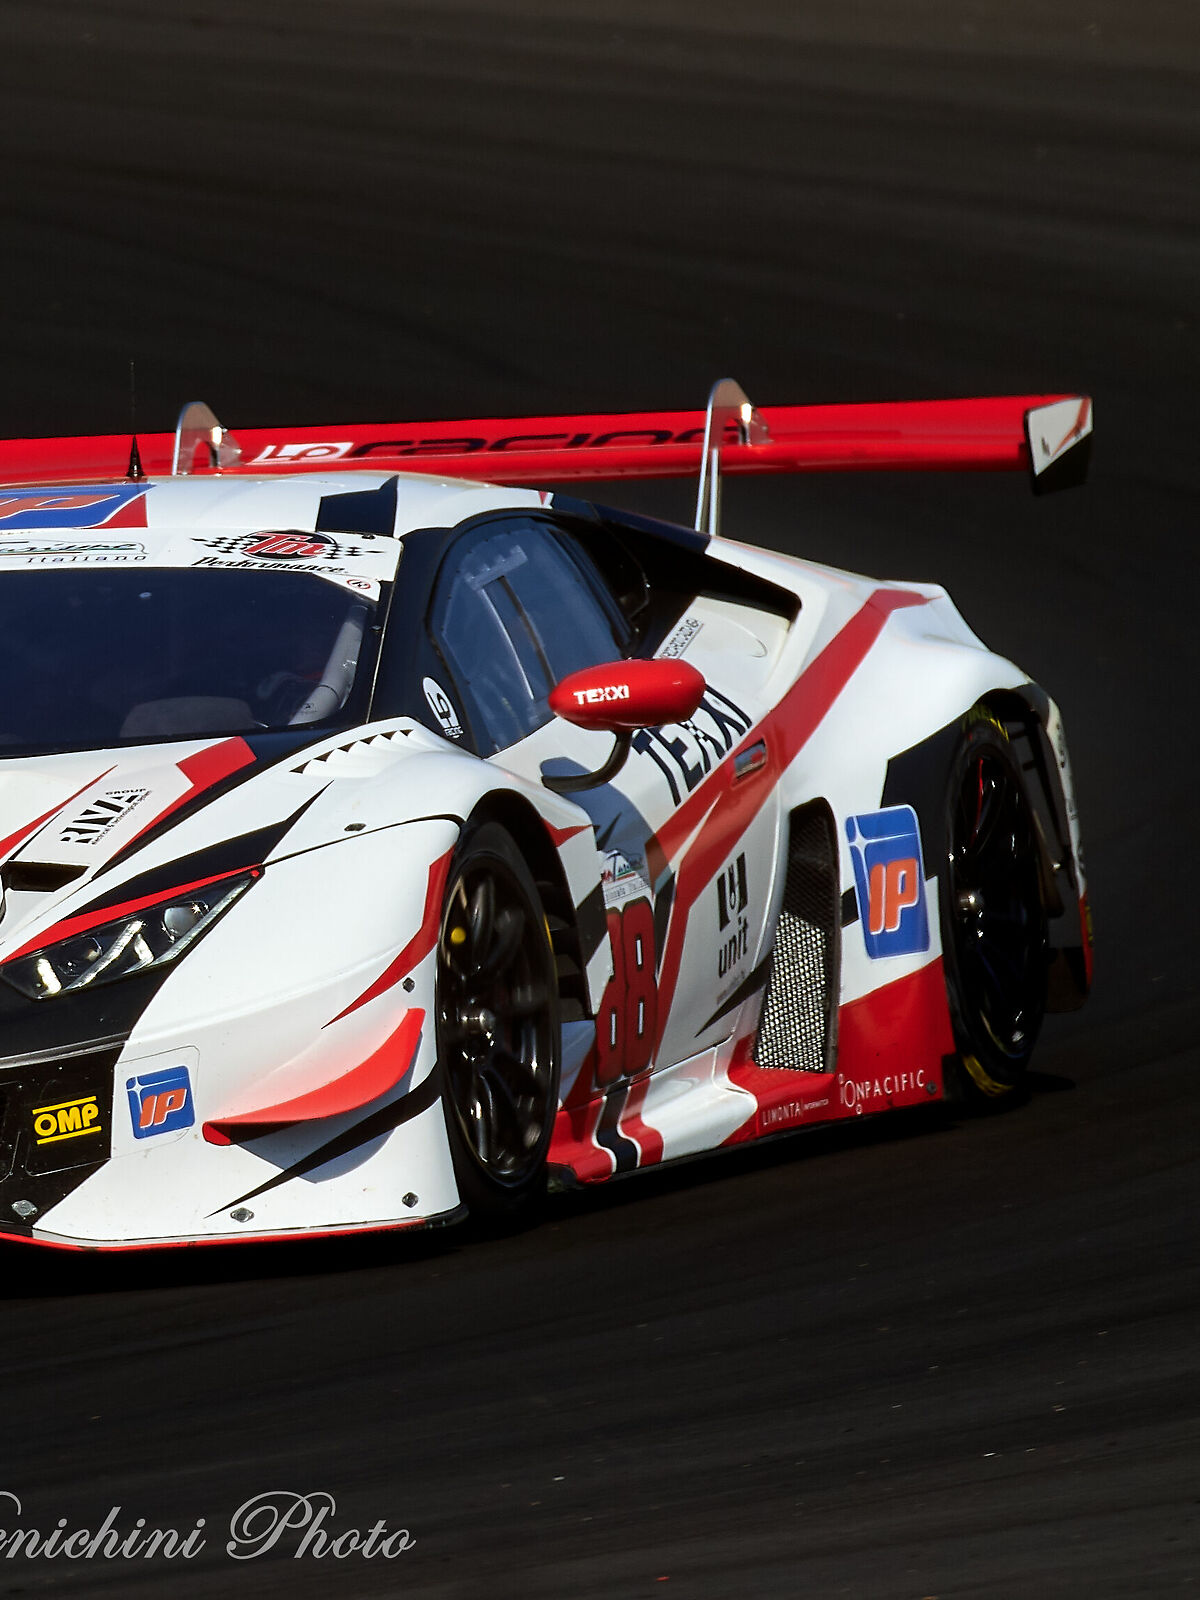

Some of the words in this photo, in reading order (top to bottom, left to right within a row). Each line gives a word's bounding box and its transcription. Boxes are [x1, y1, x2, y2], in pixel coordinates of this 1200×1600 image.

[27, 554, 147, 565] Italiano
[573, 684, 630, 705] TEXXI
[718, 915, 749, 979] unit
[34, 1103, 99, 1137] OMP
[139, 1087, 188, 1129] IP
